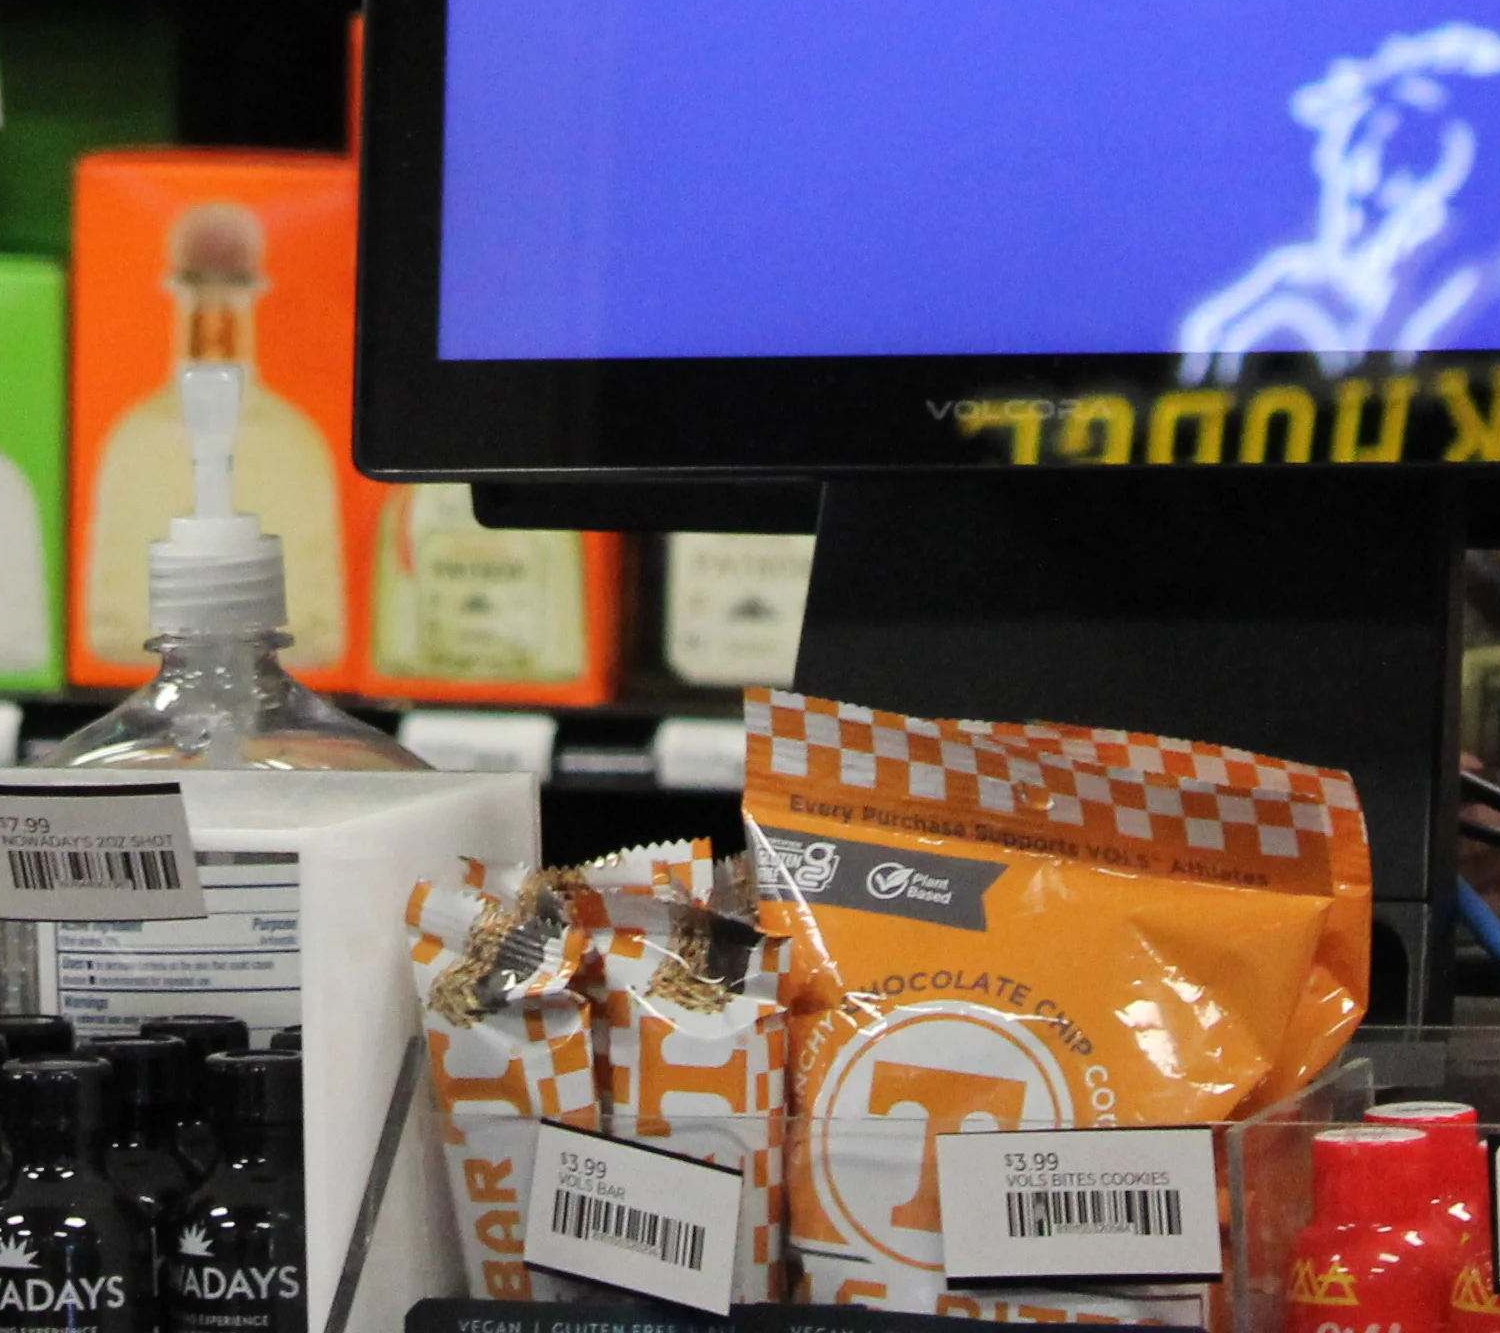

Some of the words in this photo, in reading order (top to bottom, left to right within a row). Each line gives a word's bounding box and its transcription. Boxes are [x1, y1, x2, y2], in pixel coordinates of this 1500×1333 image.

[925, 400, 1112, 421] VOLCORA
[0, 816, 50, 834] $7.99
[1, 834, 93, 848] NOWADAYS
[130, 834, 174, 847] SHOT
[789, 794, 854, 825] Every
[860, 807, 967, 839] Purchase
[974, 823, 1079, 860] Supports
[1171, 859, 1270, 887] Athletes
[912, 873, 950, 892] Plant
[907, 886, 951, 907] Based
[1035, 998, 1095, 1057] CHIP
[560, 1151, 608, 1179] $3.99
[1004, 1152, 1059, 1172] $3.99
[557, 1170, 595, 1194] VOLS
[597, 1182, 627, 1201] BAR
[1006, 1173, 1048, 1187] VOLS
[1052, 1172, 1096, 1186] BITES
[1100, 1171, 1171, 1187] COOKIES
[464, 1157, 534, 1302] BAR
[196, 1314, 270, 1328] EXPERIENCE
